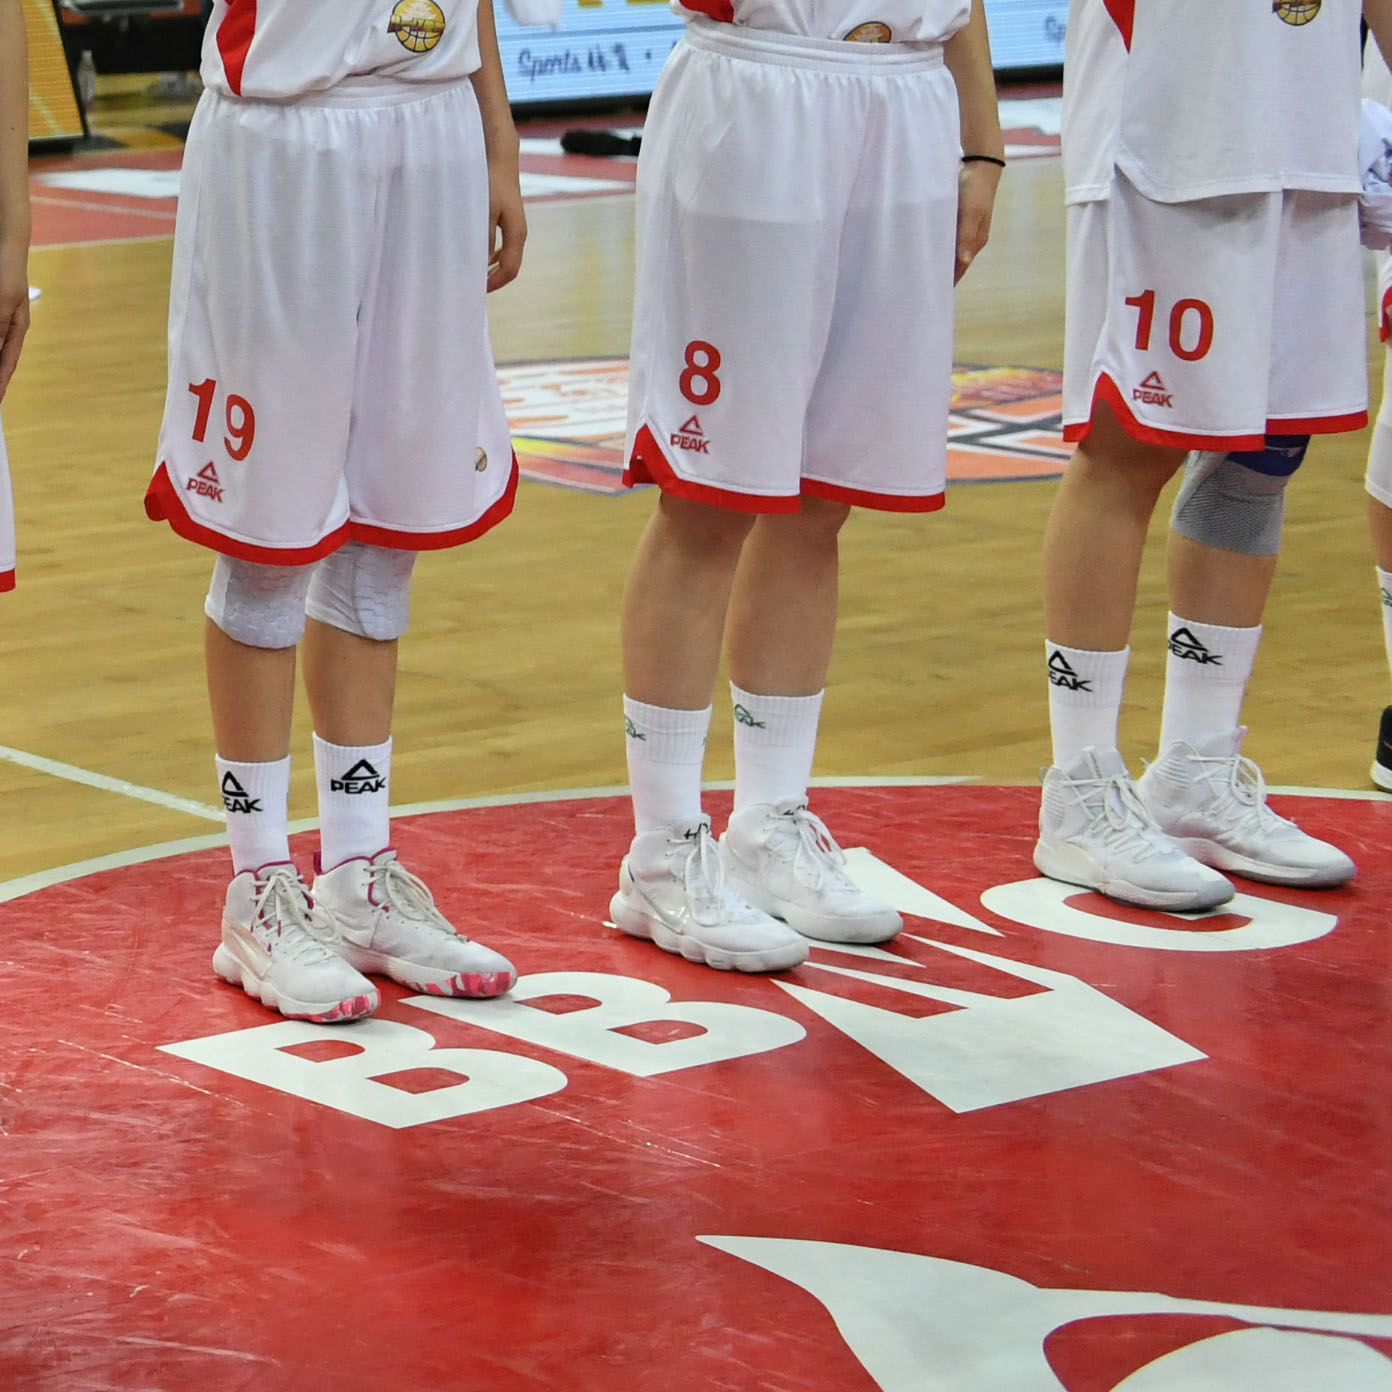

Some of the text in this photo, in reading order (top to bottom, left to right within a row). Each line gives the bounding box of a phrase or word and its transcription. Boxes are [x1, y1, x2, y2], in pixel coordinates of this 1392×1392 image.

[1124, 288, 1215, 362] 10
[678, 339, 722, 406] 8
[1133, 388, 1174, 409] PEAK
[188, 377, 256, 461] 19
[669, 434, 710, 455] PEAK
[186, 477, 226, 504] PEAK
[1048, 672, 1093, 693] EAK
[330, 776, 387, 795] PEAK
[222, 795, 263, 813] EAK
